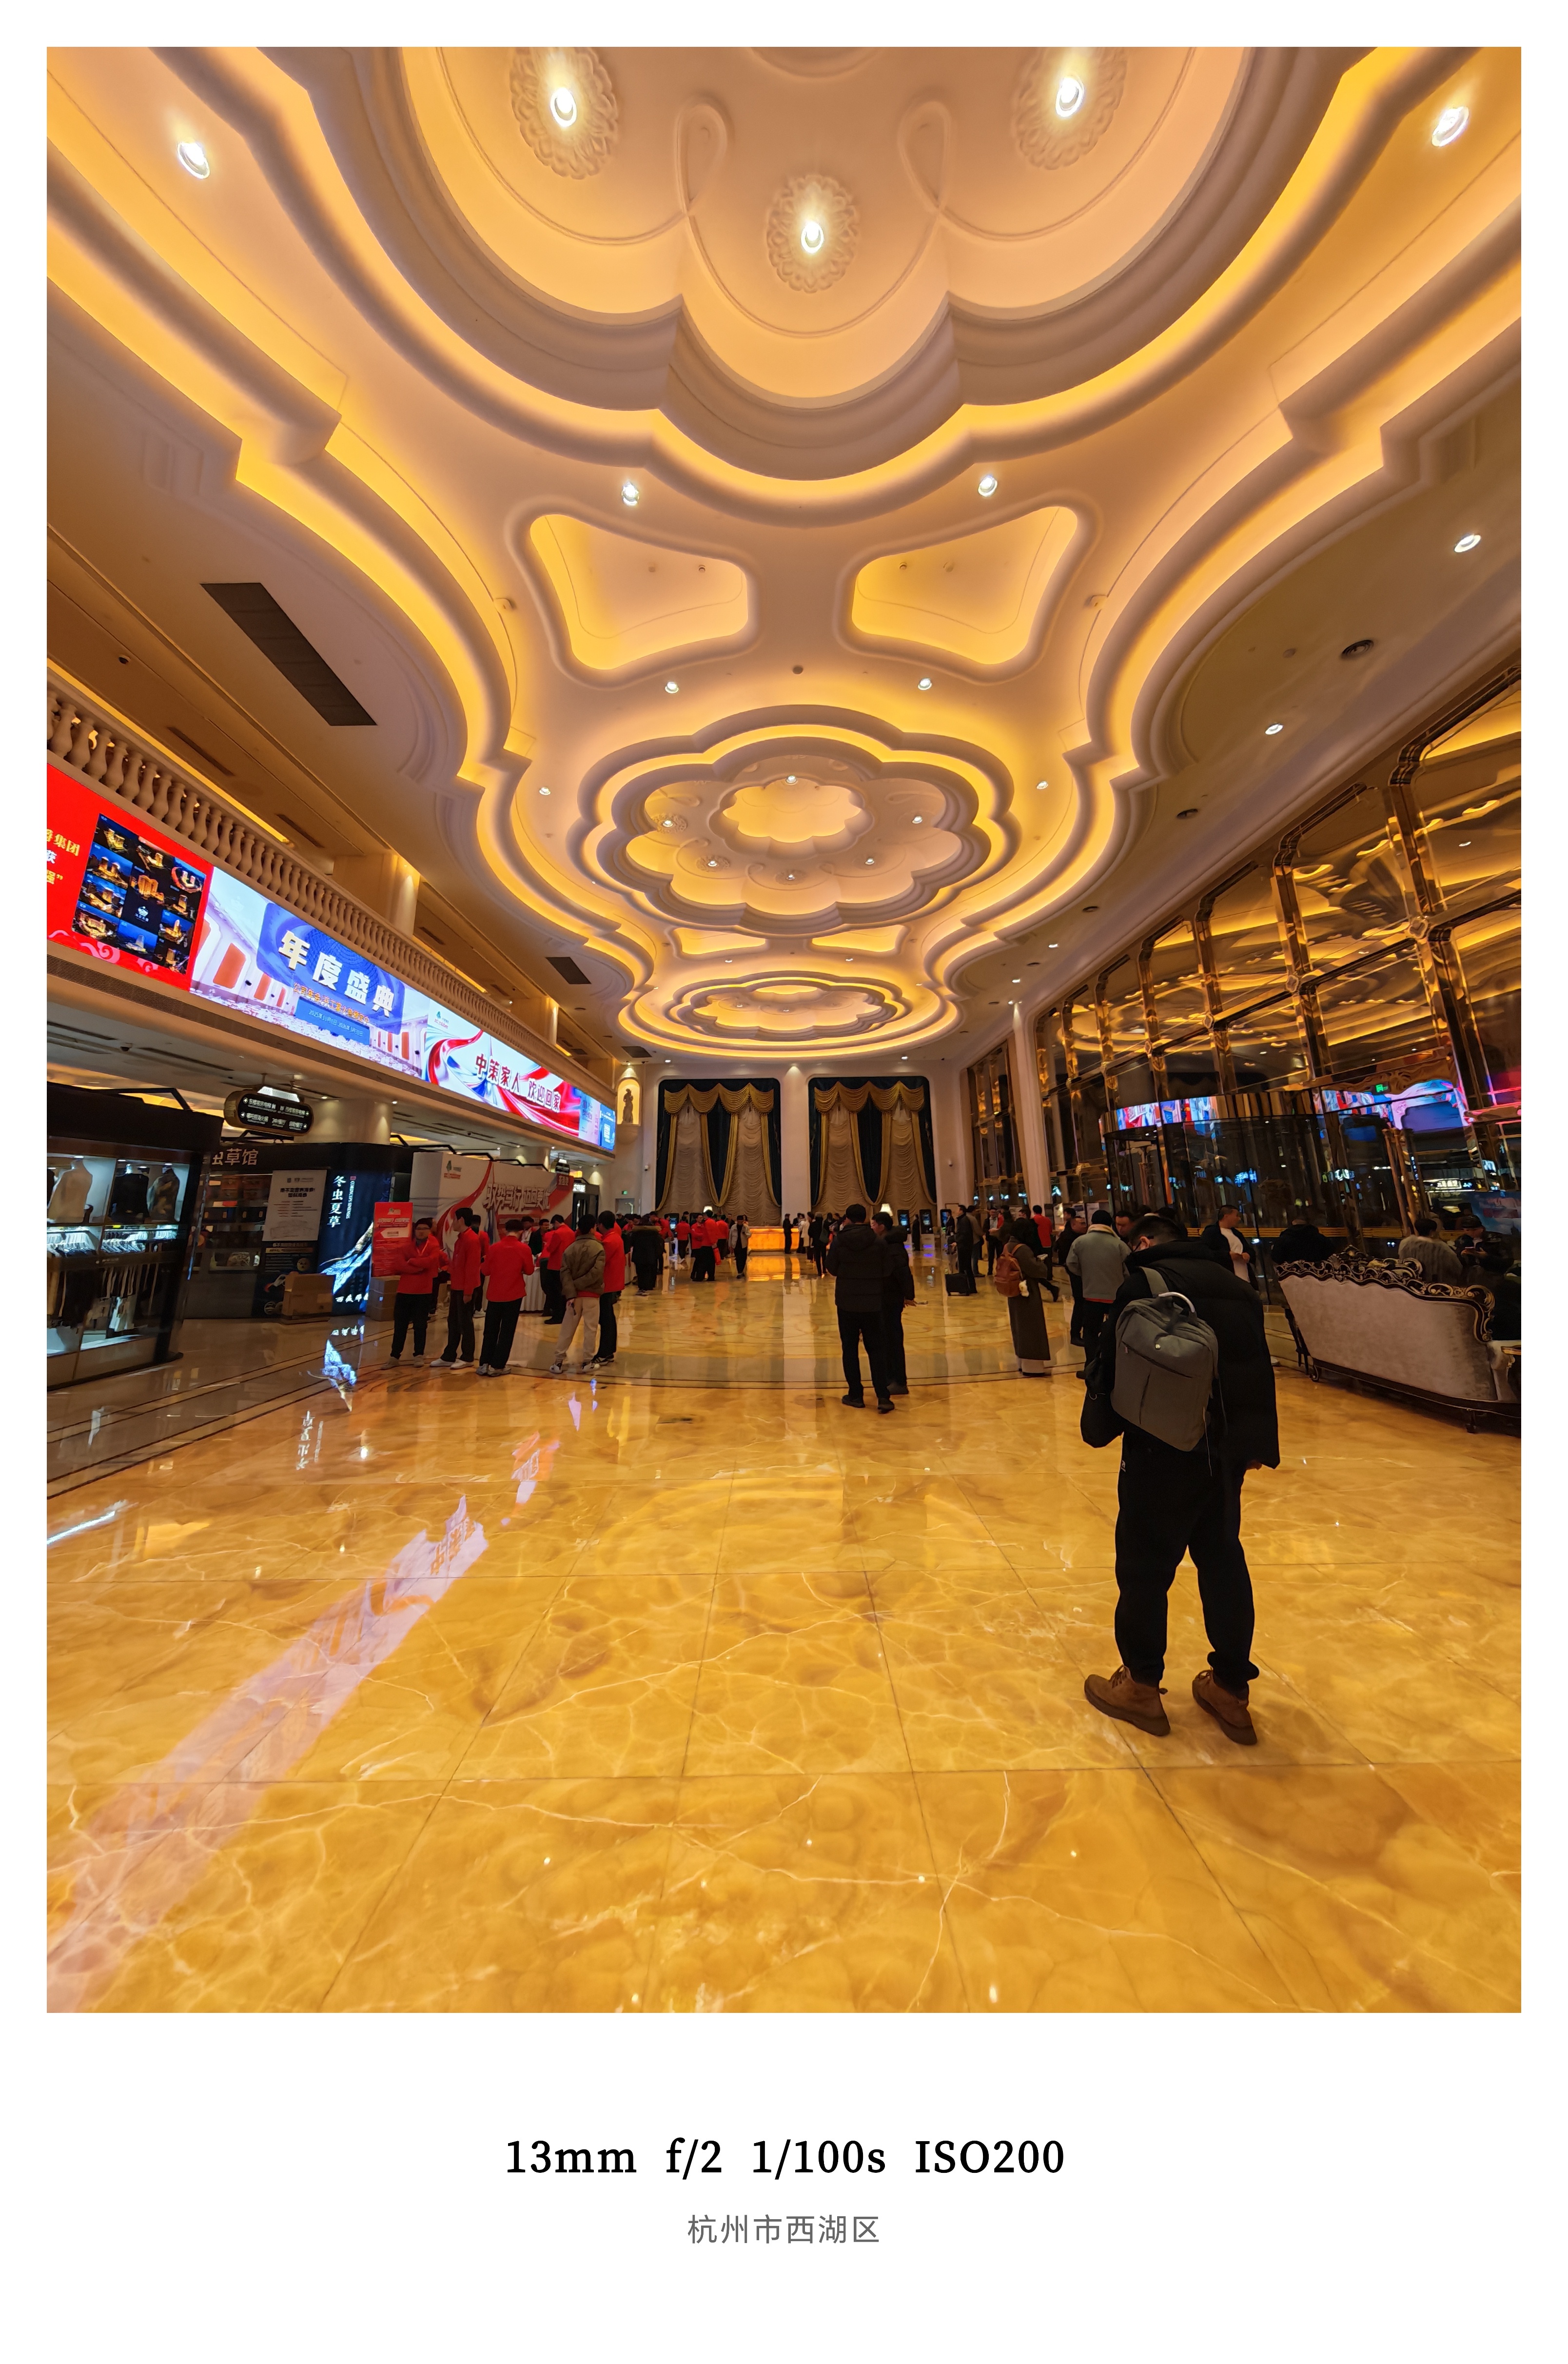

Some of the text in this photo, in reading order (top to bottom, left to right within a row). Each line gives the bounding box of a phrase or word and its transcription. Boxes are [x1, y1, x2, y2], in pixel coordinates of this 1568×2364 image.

[278, 930, 394, 1018] 年度盛典
[475, 1053, 520, 1093] 中策家人
[528, 1079, 561, 1112] 欢迎回家
[327, 1175, 346, 1228] 冬虫夏草
